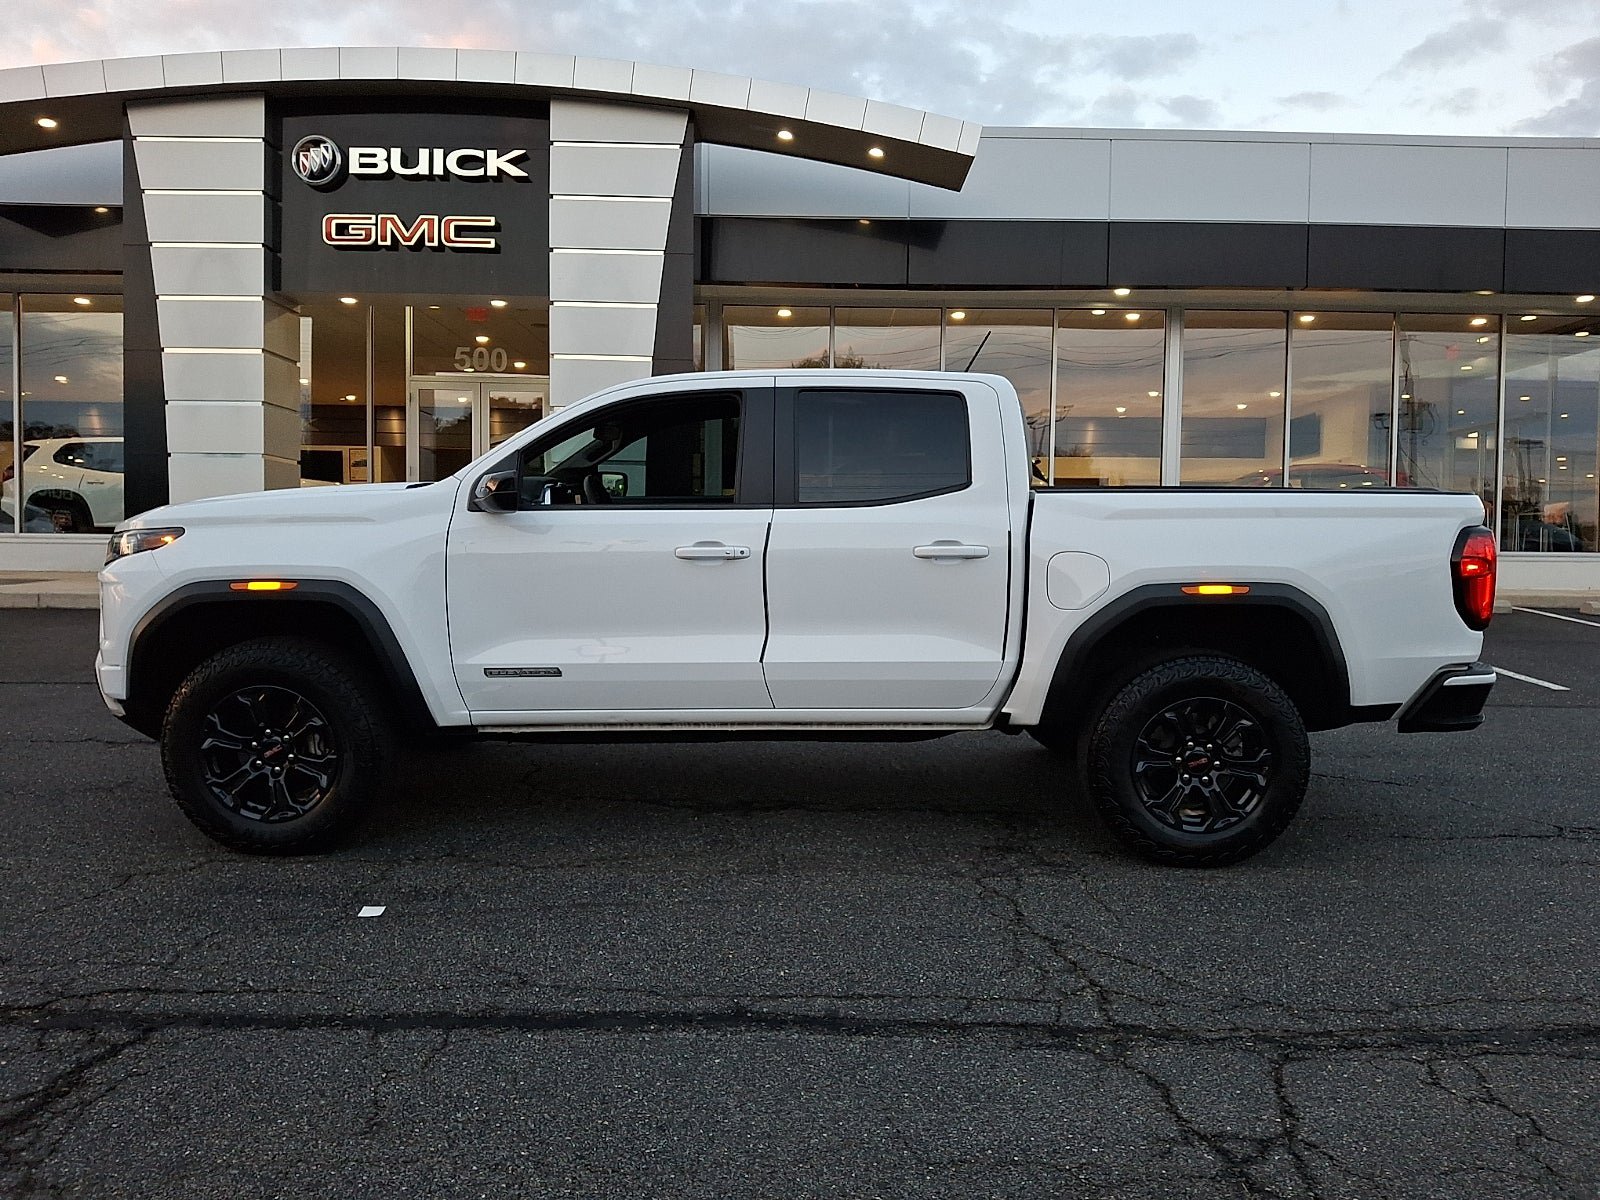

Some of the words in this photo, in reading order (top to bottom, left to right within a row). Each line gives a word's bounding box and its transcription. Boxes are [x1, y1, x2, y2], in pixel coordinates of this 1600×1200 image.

[348, 147, 529, 177] BUICK
[322, 213, 496, 249] GMC
[453, 346, 508, 372] 500
